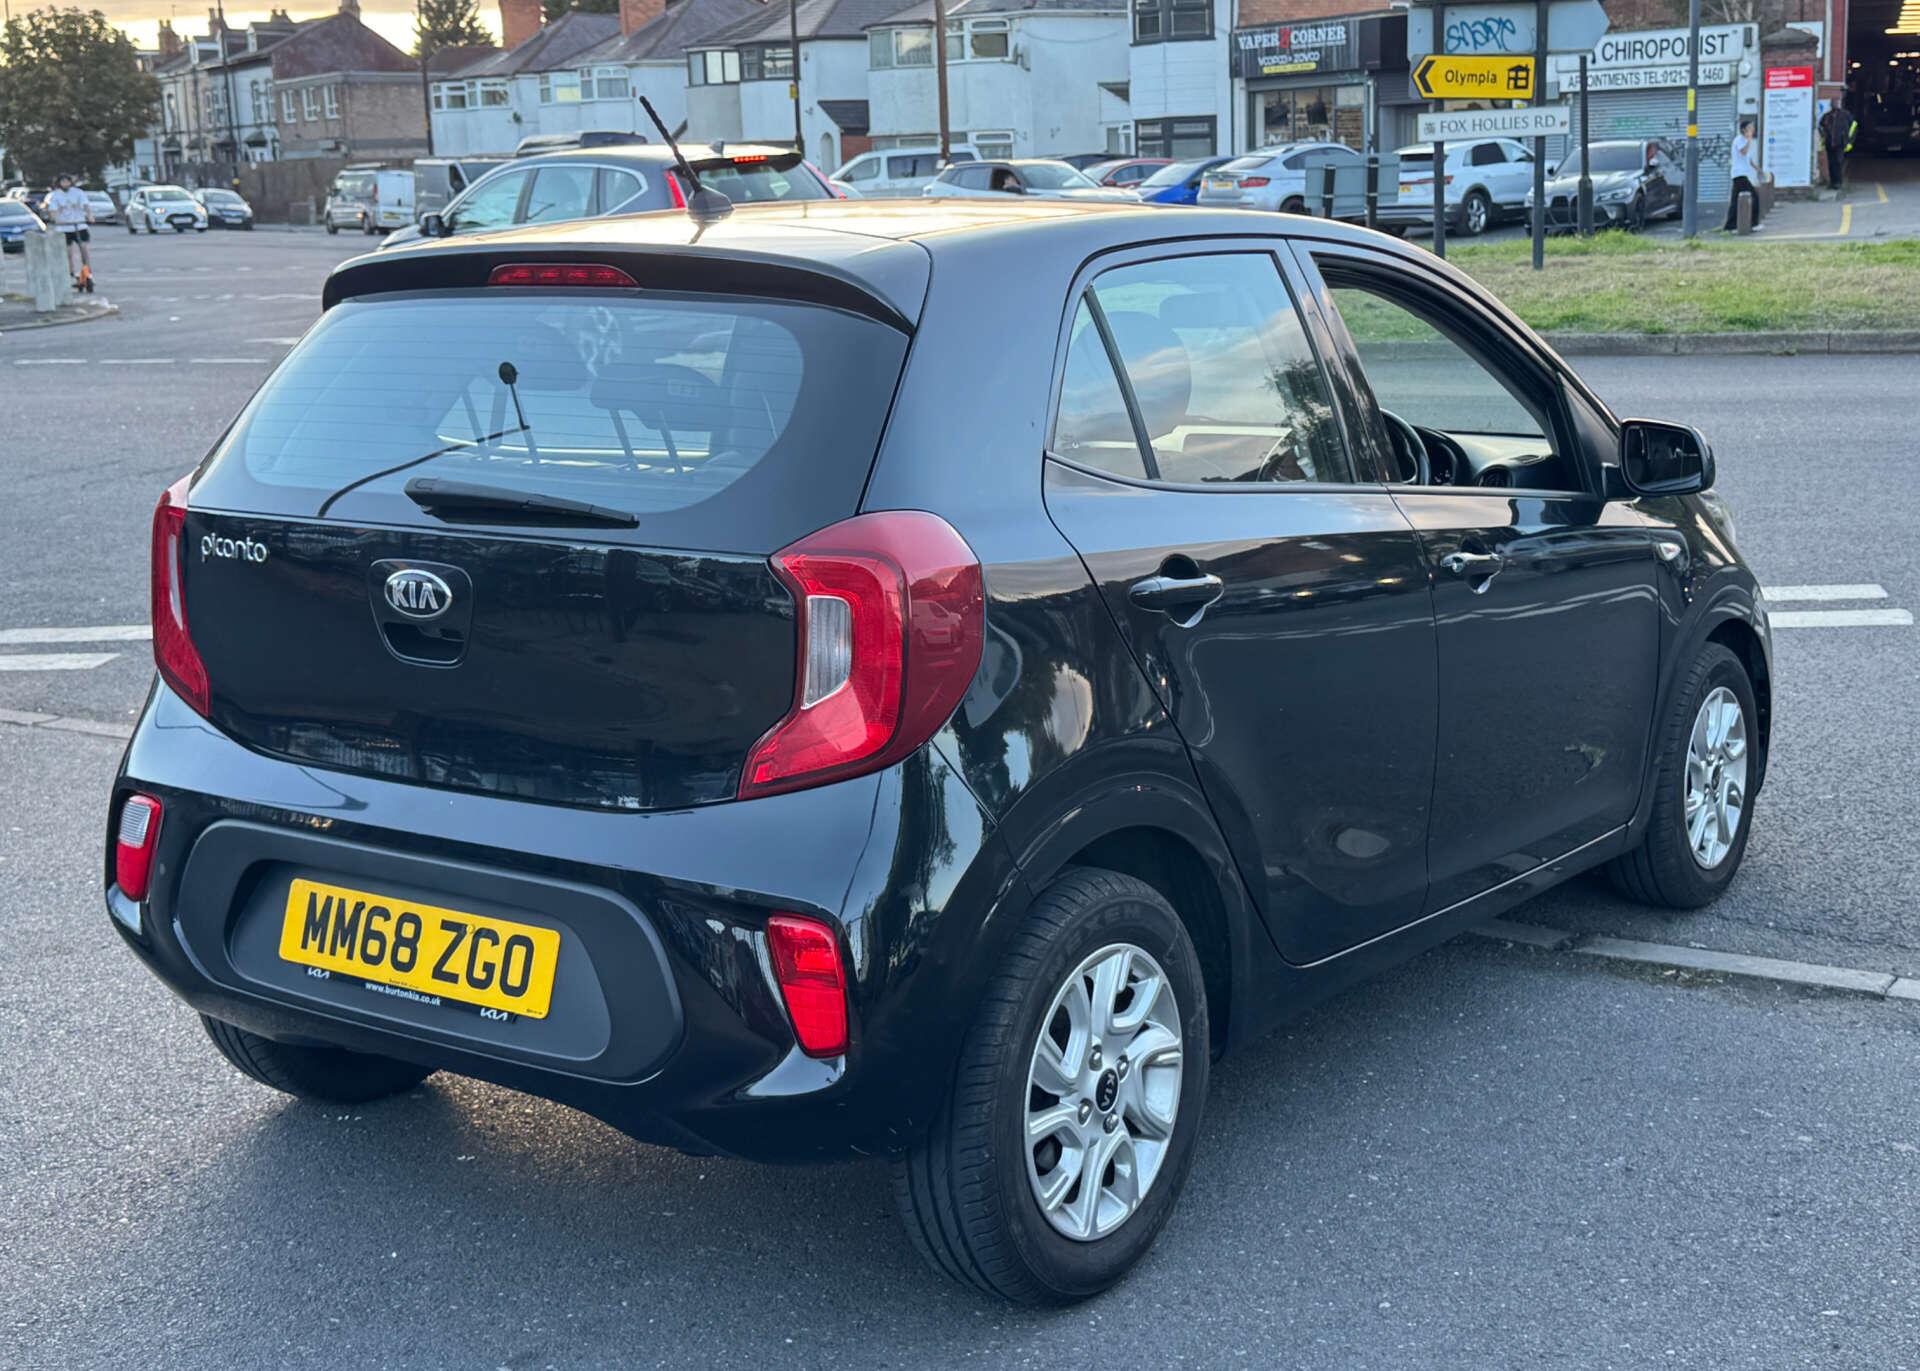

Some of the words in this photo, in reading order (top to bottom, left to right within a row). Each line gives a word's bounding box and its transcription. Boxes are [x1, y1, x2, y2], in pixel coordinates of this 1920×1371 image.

[1290, 25, 1346, 44] CORNER
[1445, 69, 1497, 86] Olympia
[1440, 119, 1467, 133] FOX
[1472, 115, 1529, 132] HOLLIES
[1534, 114, 1556, 129] RD
[201, 532, 268, 563] picanto
[390, 579, 439, 610] KIA
[301, 891, 423, 974] MM68
[431, 918, 535, 998] ZGO
[364, 981, 441, 1007] www.burtonkia.co.uk
